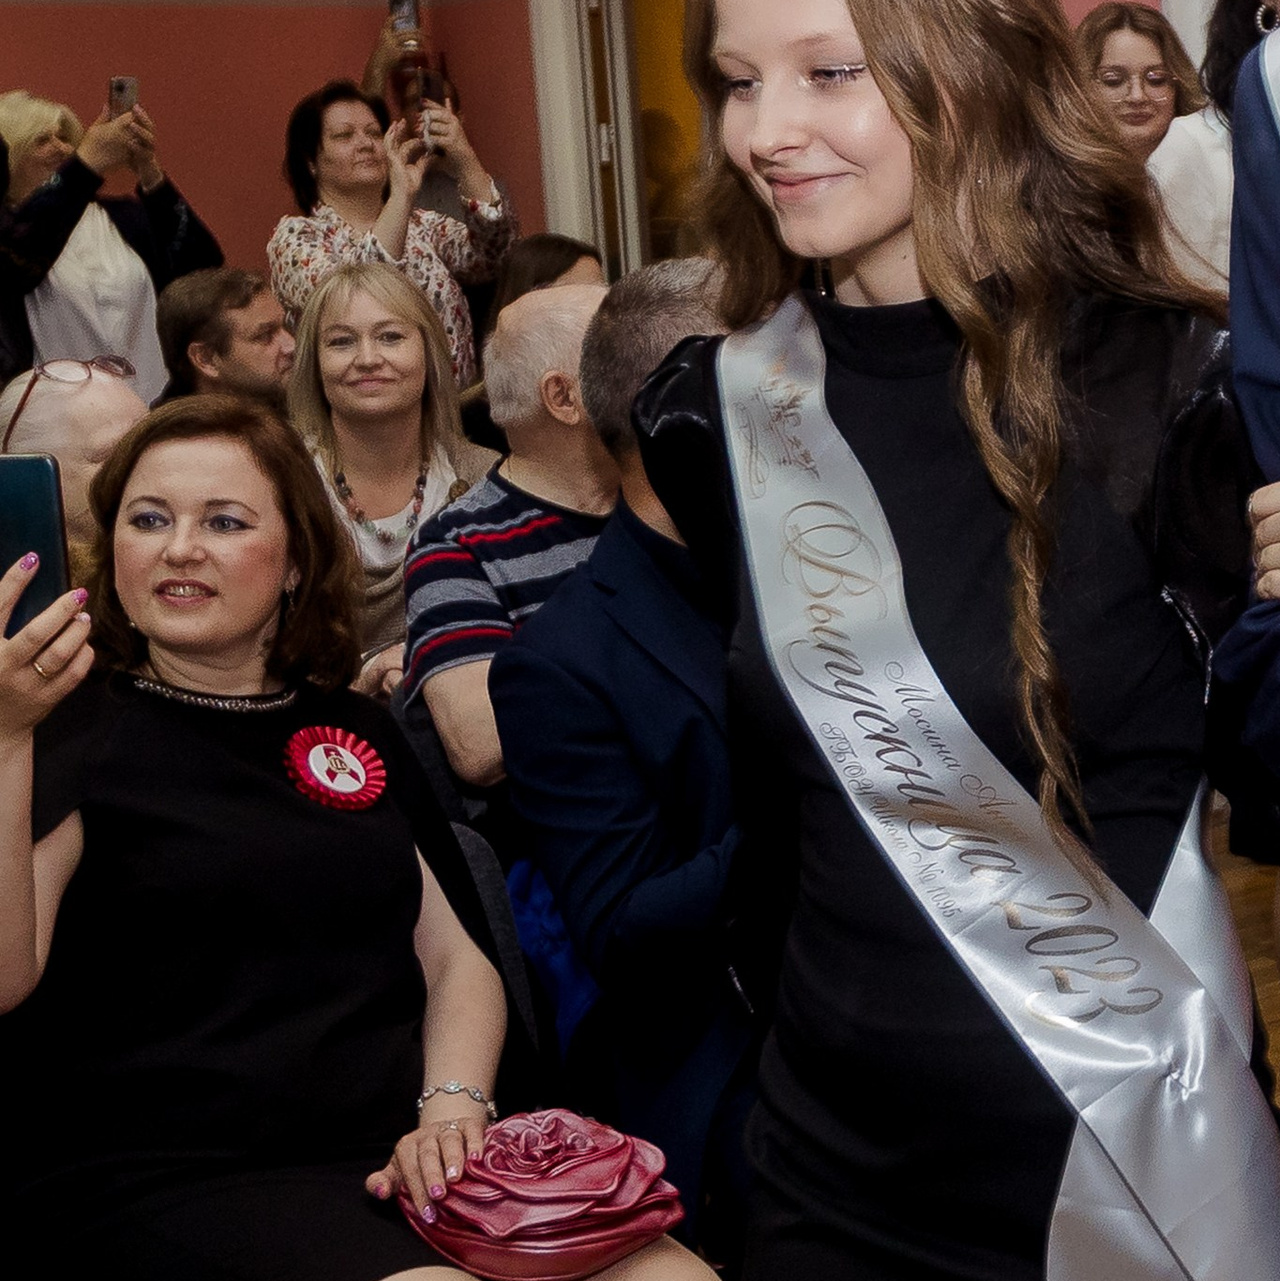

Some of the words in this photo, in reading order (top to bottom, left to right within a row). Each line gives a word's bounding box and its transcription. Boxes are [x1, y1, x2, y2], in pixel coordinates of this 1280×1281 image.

[884, 661, 961, 770] Мосина
[908, 851, 945, 885] №
[926, 885, 962, 919] 1095
[990, 892, 1164, 1029] 2023
